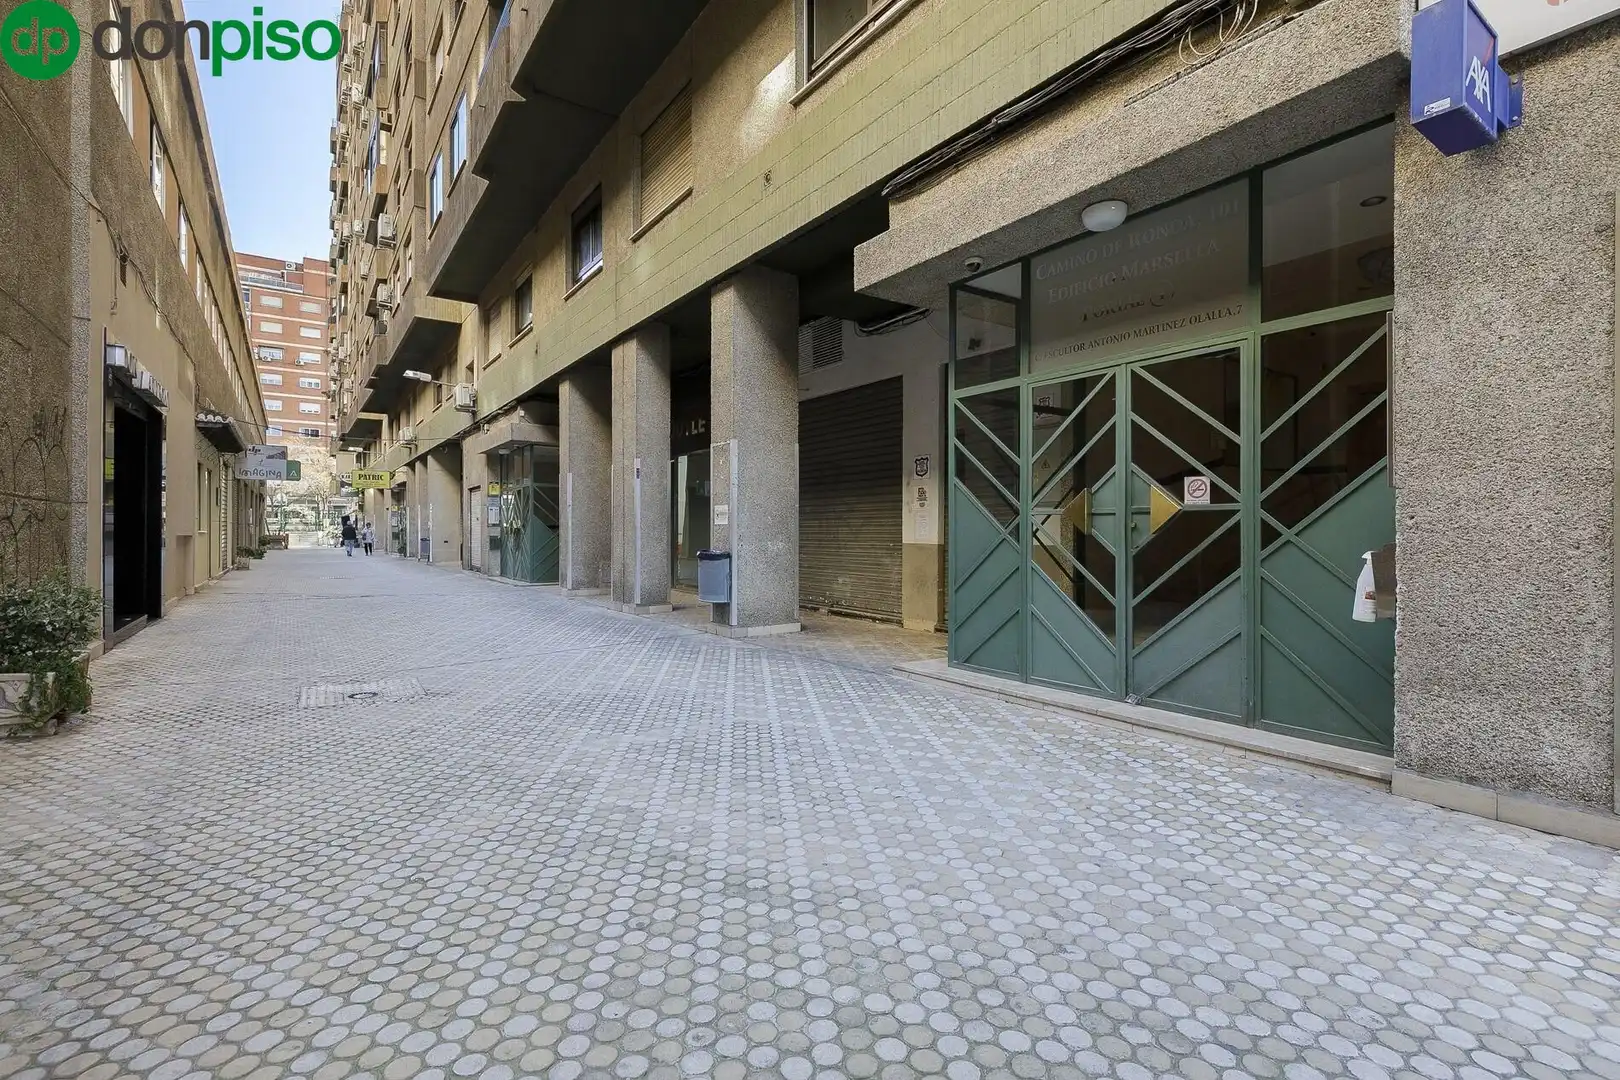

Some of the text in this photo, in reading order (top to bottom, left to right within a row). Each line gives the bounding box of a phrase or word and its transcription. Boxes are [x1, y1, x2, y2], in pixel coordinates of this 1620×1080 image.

[1465, 55, 1492, 113] AXA
[1035, 249, 1099, 281] CAMINO
[1047, 271, 1118, 304] EDIFICIO
[1121, 239, 1221, 279] MARSELLA
[1087, 331, 1131, 351] ANTONIO
[1133, 318, 1187, 339] MARTINEZ
[358, 473, 385, 481] PATRIC
